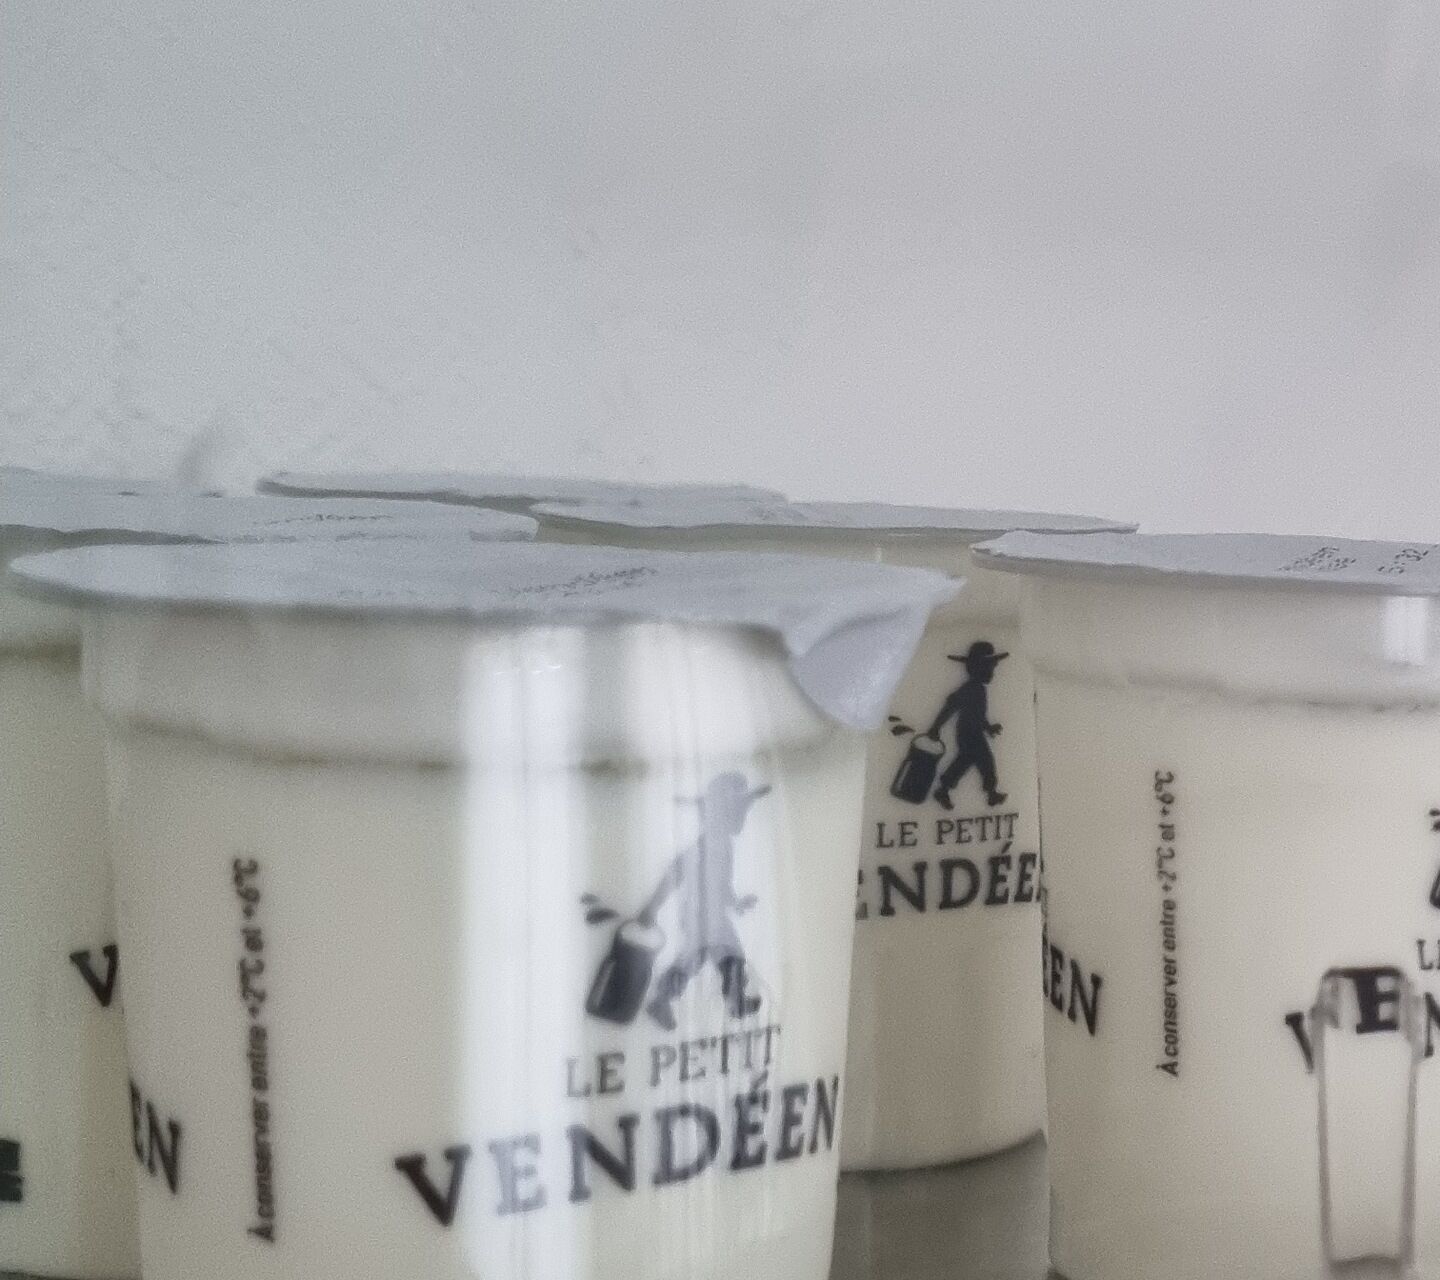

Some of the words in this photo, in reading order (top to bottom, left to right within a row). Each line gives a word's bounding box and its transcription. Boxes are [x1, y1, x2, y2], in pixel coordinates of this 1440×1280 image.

[875, 821, 919, 849] LE
[935, 812, 1020, 846] PETIT
[1158, 823, 1176, 843] et
[1159, 898, 1177, 952] entre
[1160, 956, 1179, 1058] conserver
[565, 1052, 626, 1099] LE
[648, 1023, 782, 1088] PETIT
[394, 1070, 840, 1228] VENDÉEN
